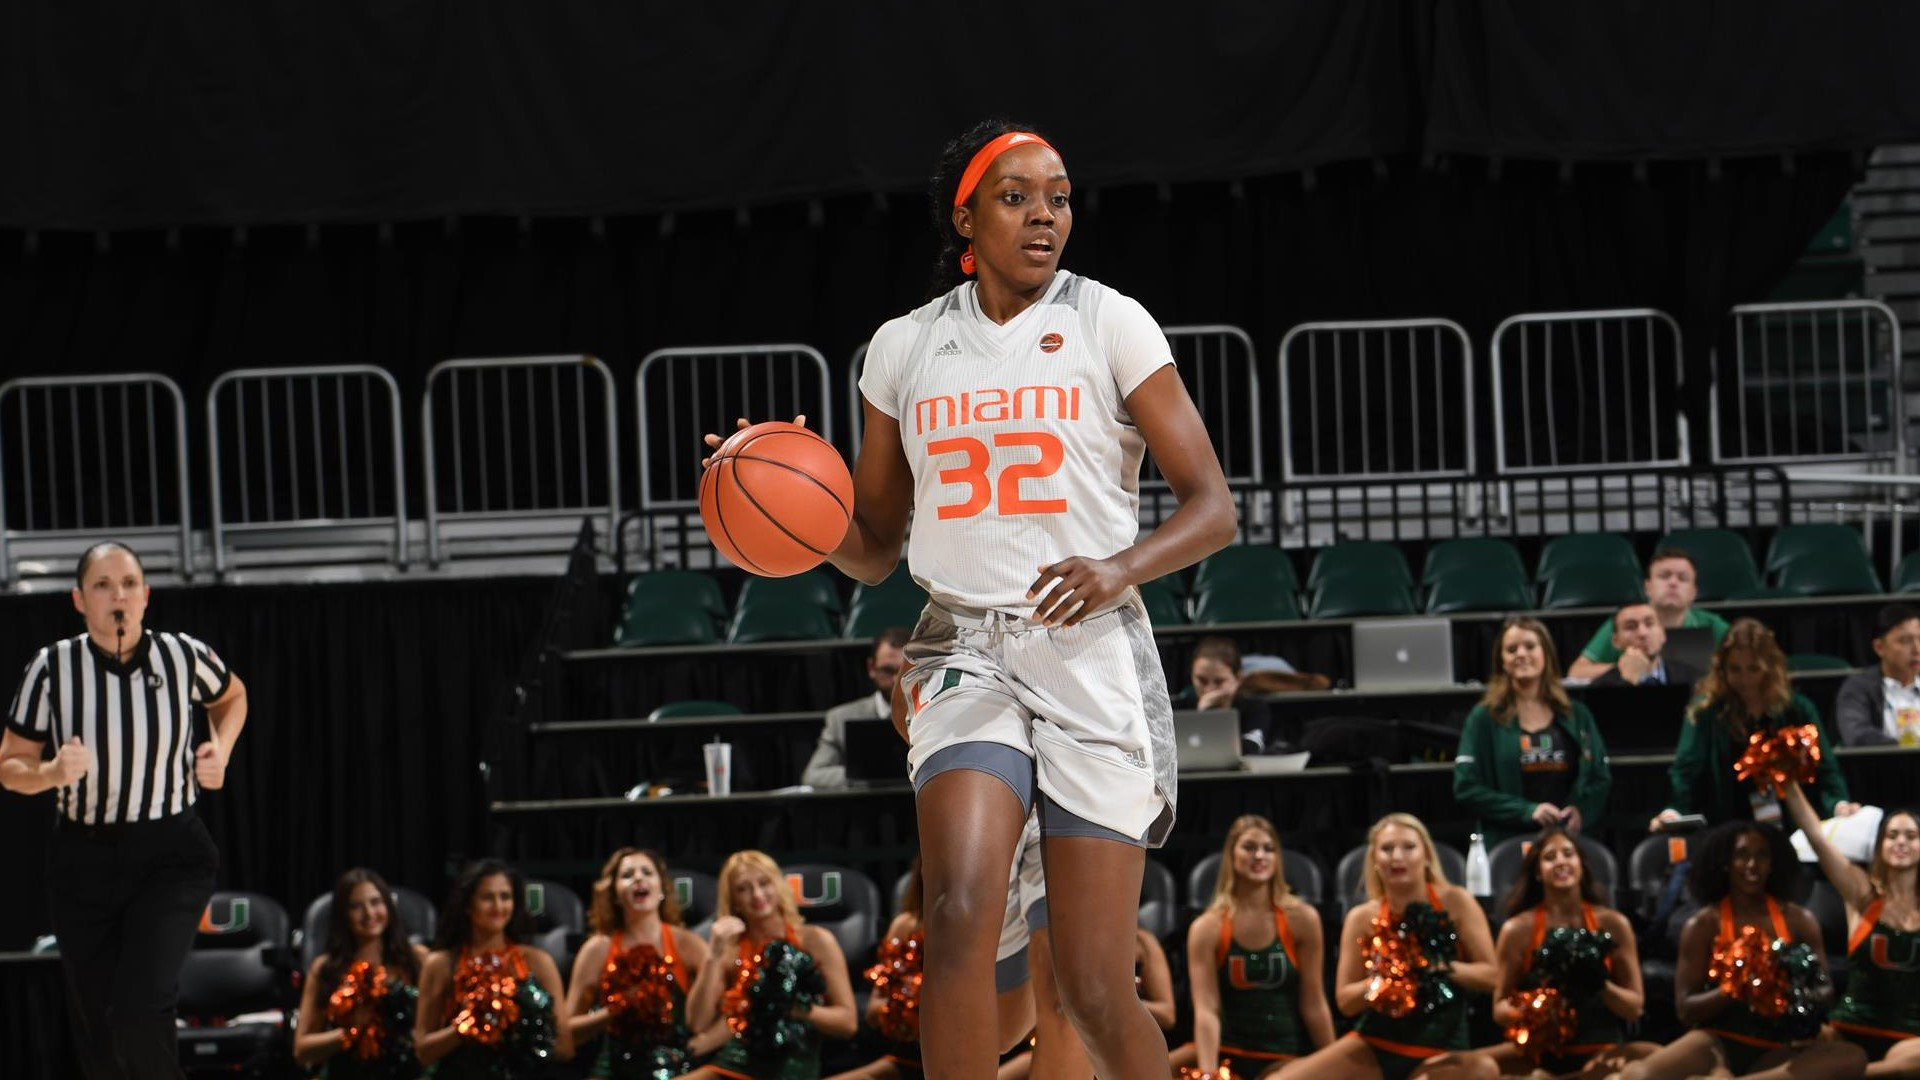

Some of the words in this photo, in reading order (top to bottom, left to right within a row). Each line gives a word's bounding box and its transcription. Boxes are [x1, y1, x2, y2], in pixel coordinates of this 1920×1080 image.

[927, 431, 1067, 520] 32
[784, 872, 842, 907] U
[199, 897, 250, 933] U
[1228, 952, 1288, 990] U
